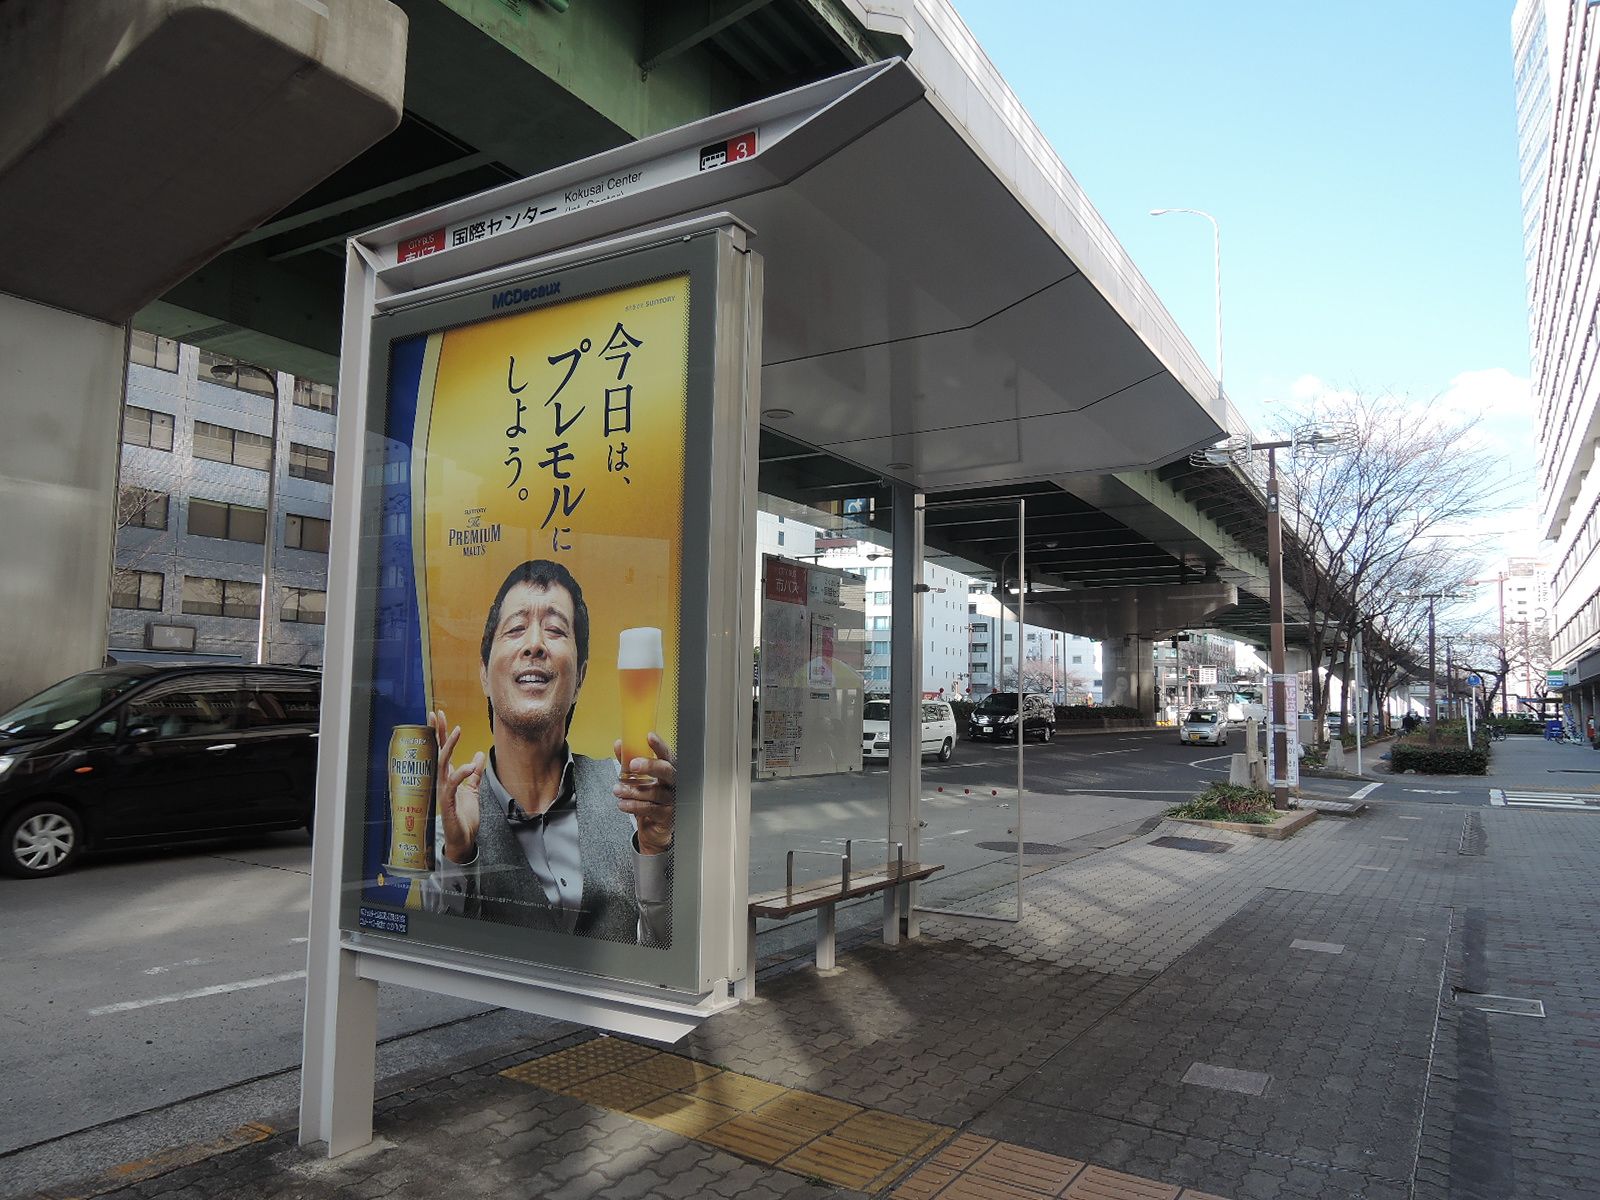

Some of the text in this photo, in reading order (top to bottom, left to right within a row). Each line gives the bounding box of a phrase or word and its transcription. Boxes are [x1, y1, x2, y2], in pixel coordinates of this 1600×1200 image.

[735, 141, 749, 161] 3
[564, 182, 605, 204] Kokusai
[607, 170, 643, 190] Center
[492, 281, 561, 310] MCDecaux
[598, 322, 643, 485] 今日は、
[504, 356, 529, 501] しよう。
[538, 338, 592, 552] プレモルに
[449, 524, 501, 546] PREMIUM
[392, 757, 432, 776] PREMIUM
